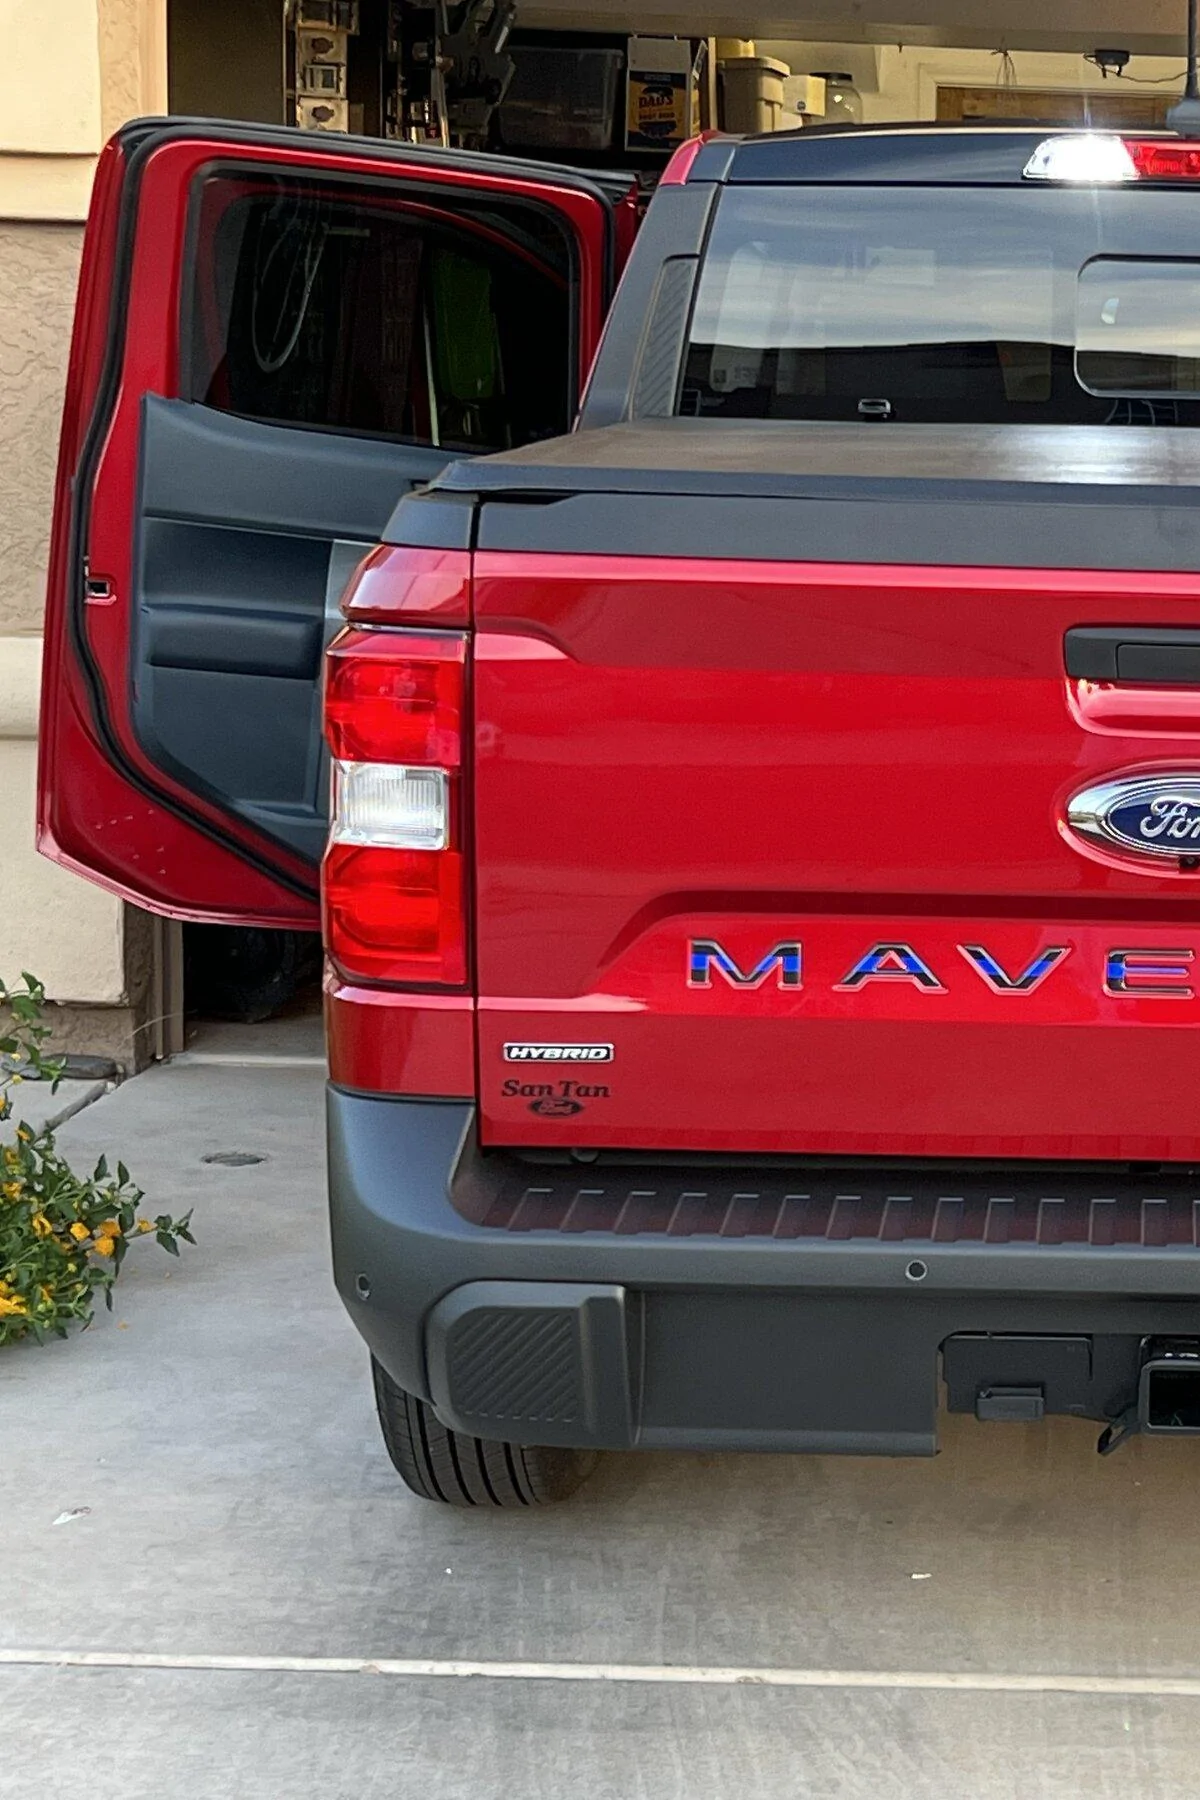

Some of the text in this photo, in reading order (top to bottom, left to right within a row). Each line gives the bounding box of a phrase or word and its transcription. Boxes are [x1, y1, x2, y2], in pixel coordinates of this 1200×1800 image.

[509, 1047, 608, 1060] HYBRID
[501, 1079, 611, 1098] San Tan
